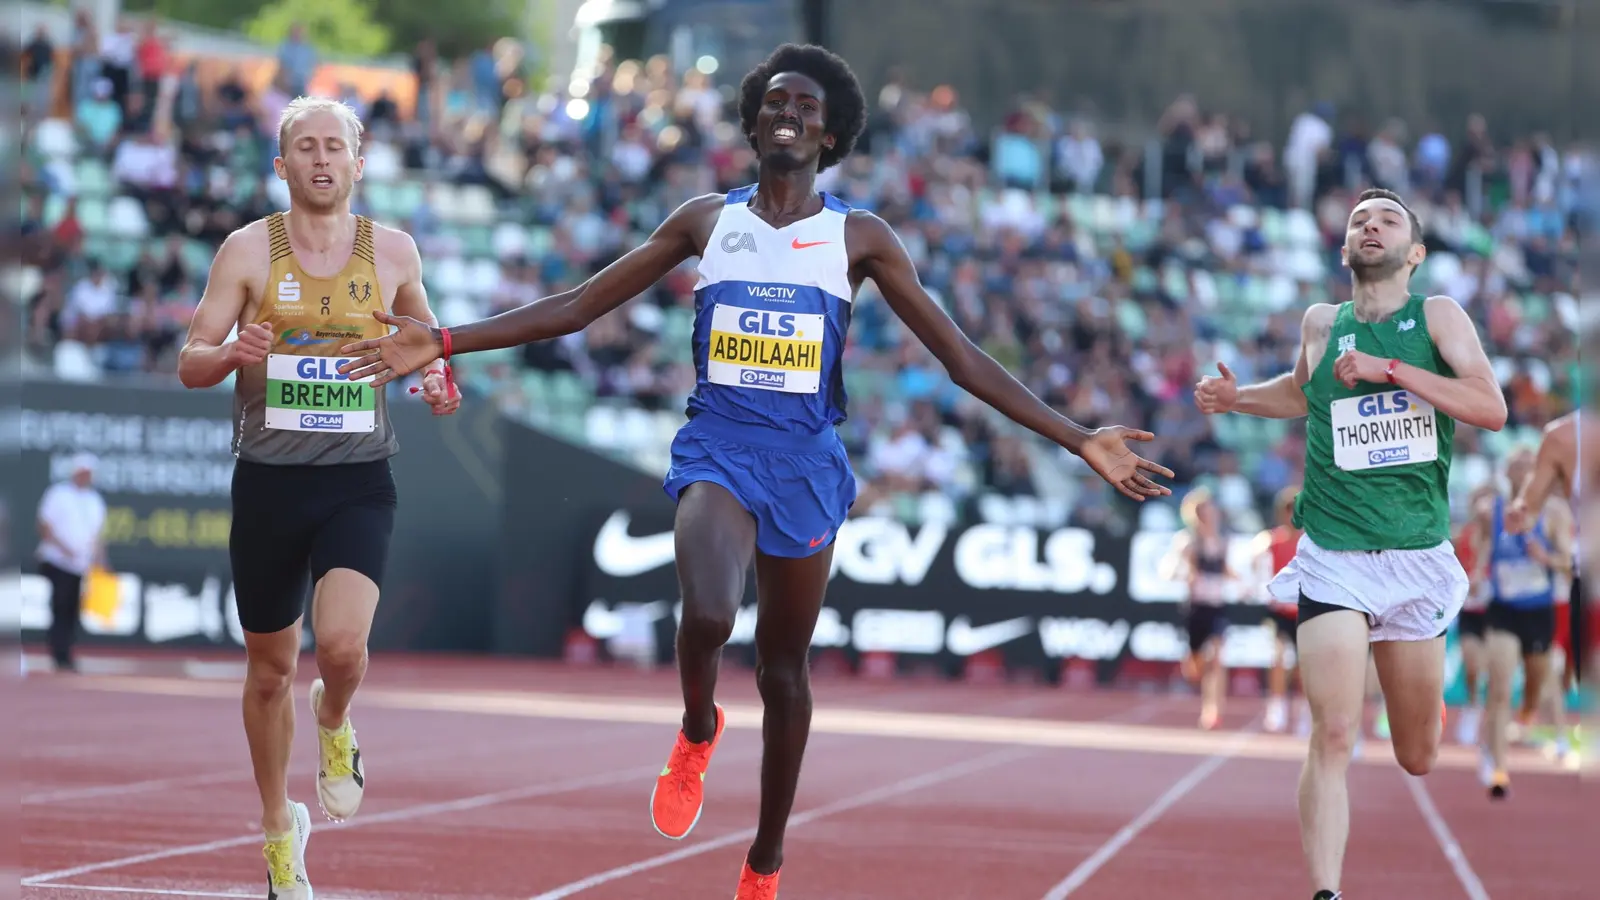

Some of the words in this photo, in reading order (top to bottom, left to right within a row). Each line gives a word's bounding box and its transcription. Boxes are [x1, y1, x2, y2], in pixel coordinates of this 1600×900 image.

[747, 285, 797, 299] VIACTIV
[713, 335, 816, 368] ABDILAAHI
[758, 373, 784, 383] PLAN
[281, 382, 363, 408] BREMM
[318, 415, 342, 425] PLAN
[1337, 415, 1433, 448] THORWIRTH
[1385, 449, 1408, 458] PLAN
[954, 522, 1118, 594] GLS.
